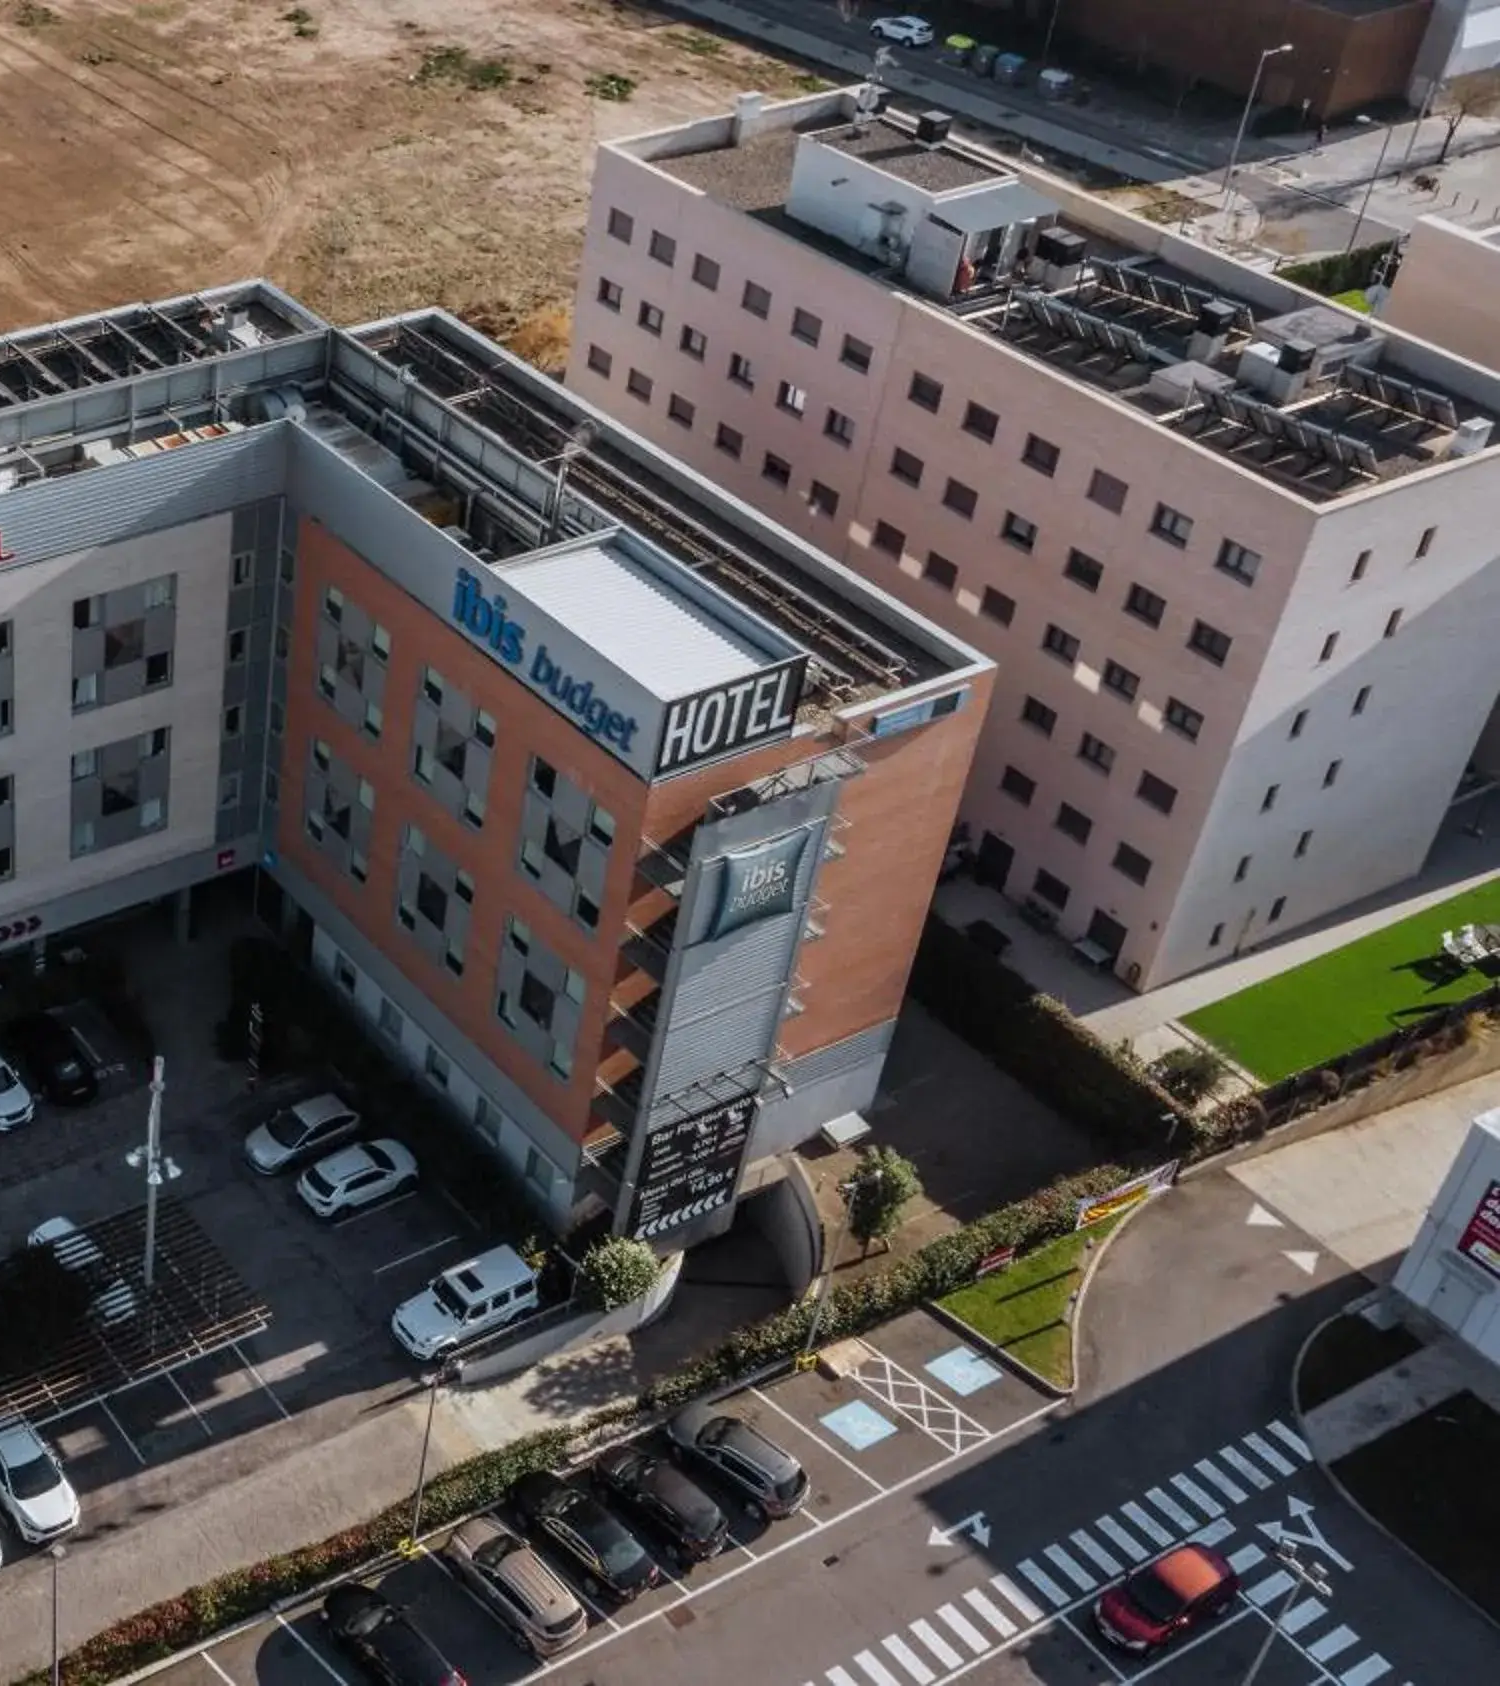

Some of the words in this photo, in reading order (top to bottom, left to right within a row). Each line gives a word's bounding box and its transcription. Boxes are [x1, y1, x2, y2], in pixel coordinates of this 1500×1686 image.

[451, 566, 526, 666] ibis
[528, 643, 639, 753] budget
[660, 667, 792, 768] HOTEL
[742, 859, 787, 893] ibis
